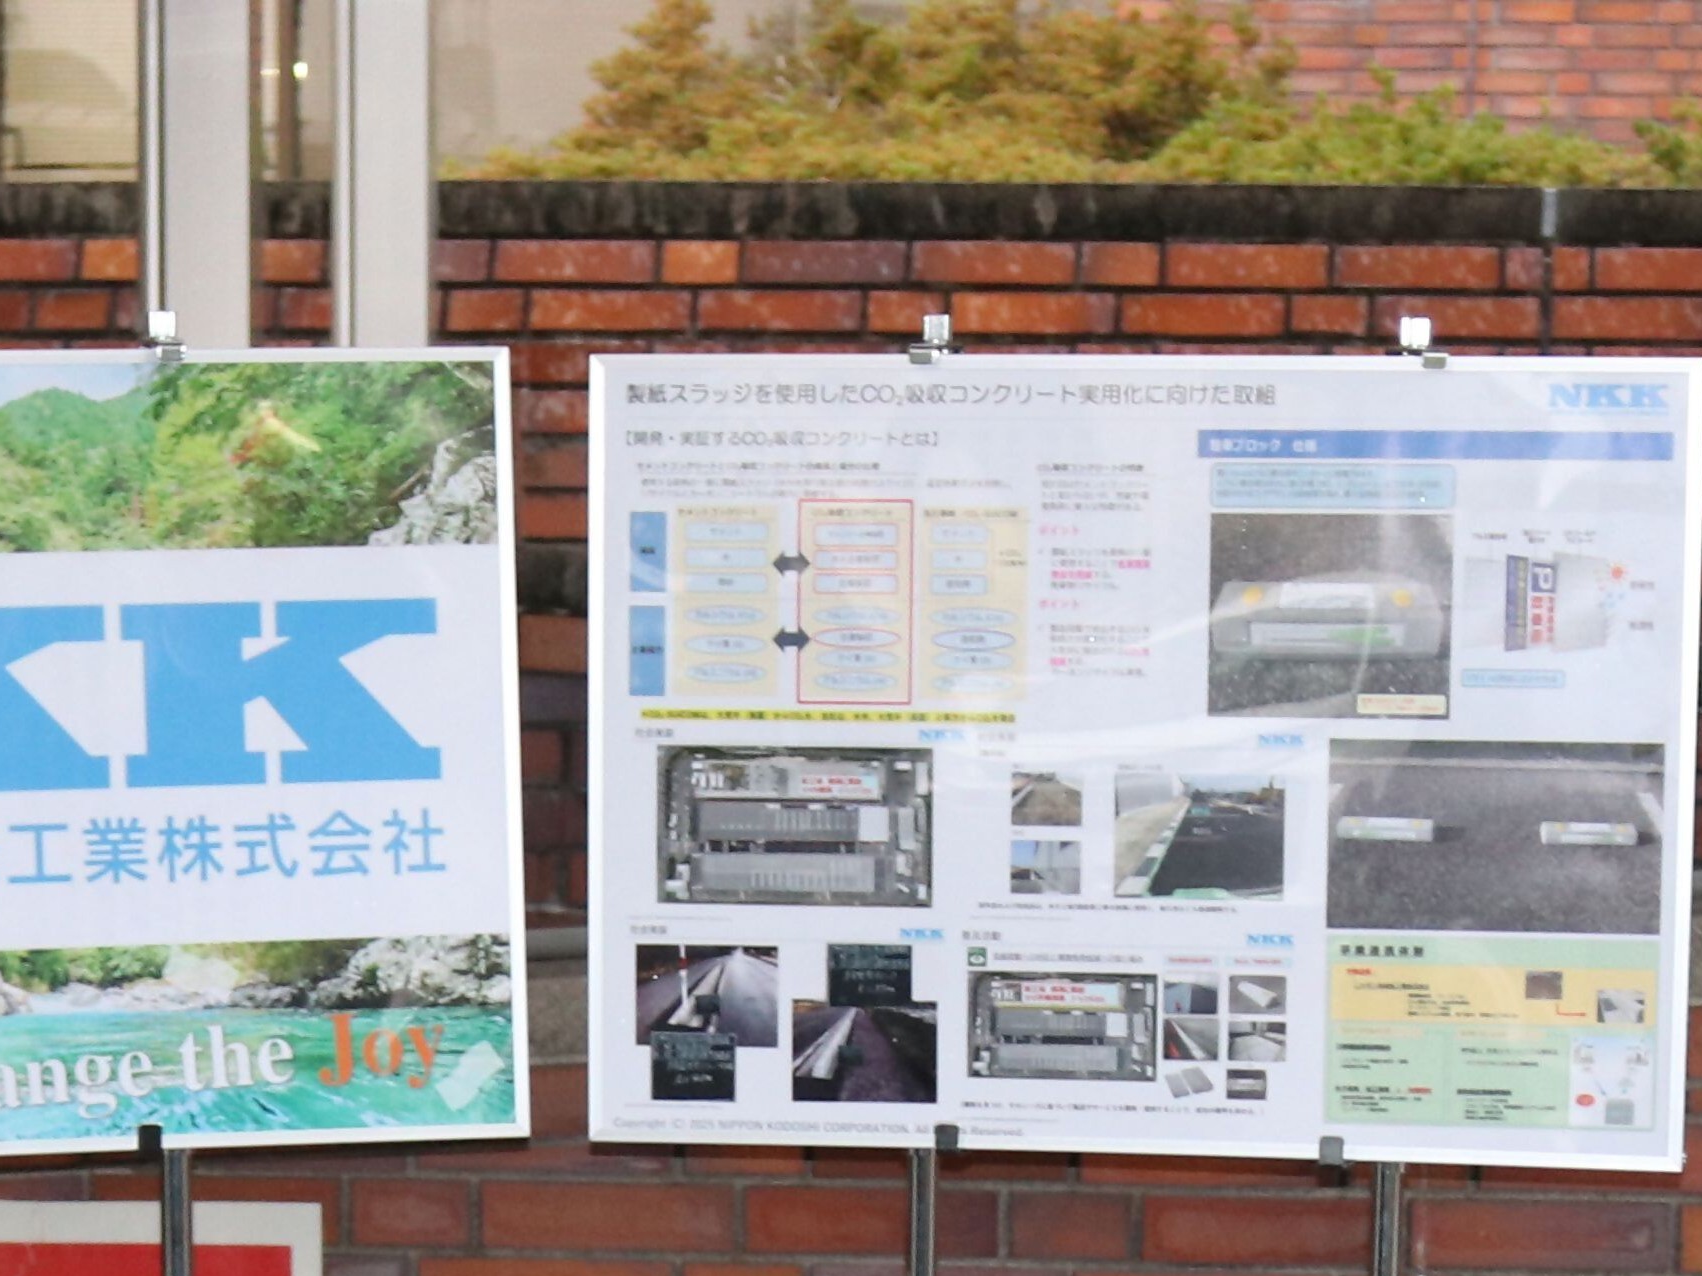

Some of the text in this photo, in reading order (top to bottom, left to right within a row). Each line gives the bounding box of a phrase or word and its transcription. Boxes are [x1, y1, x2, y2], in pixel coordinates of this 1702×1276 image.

[1547, 382, 1669, 408] NKK
[1246, 933, 1294, 946] NKK
[178, 1024, 295, 1087] the
[317, 1012, 445, 1090] Joy
